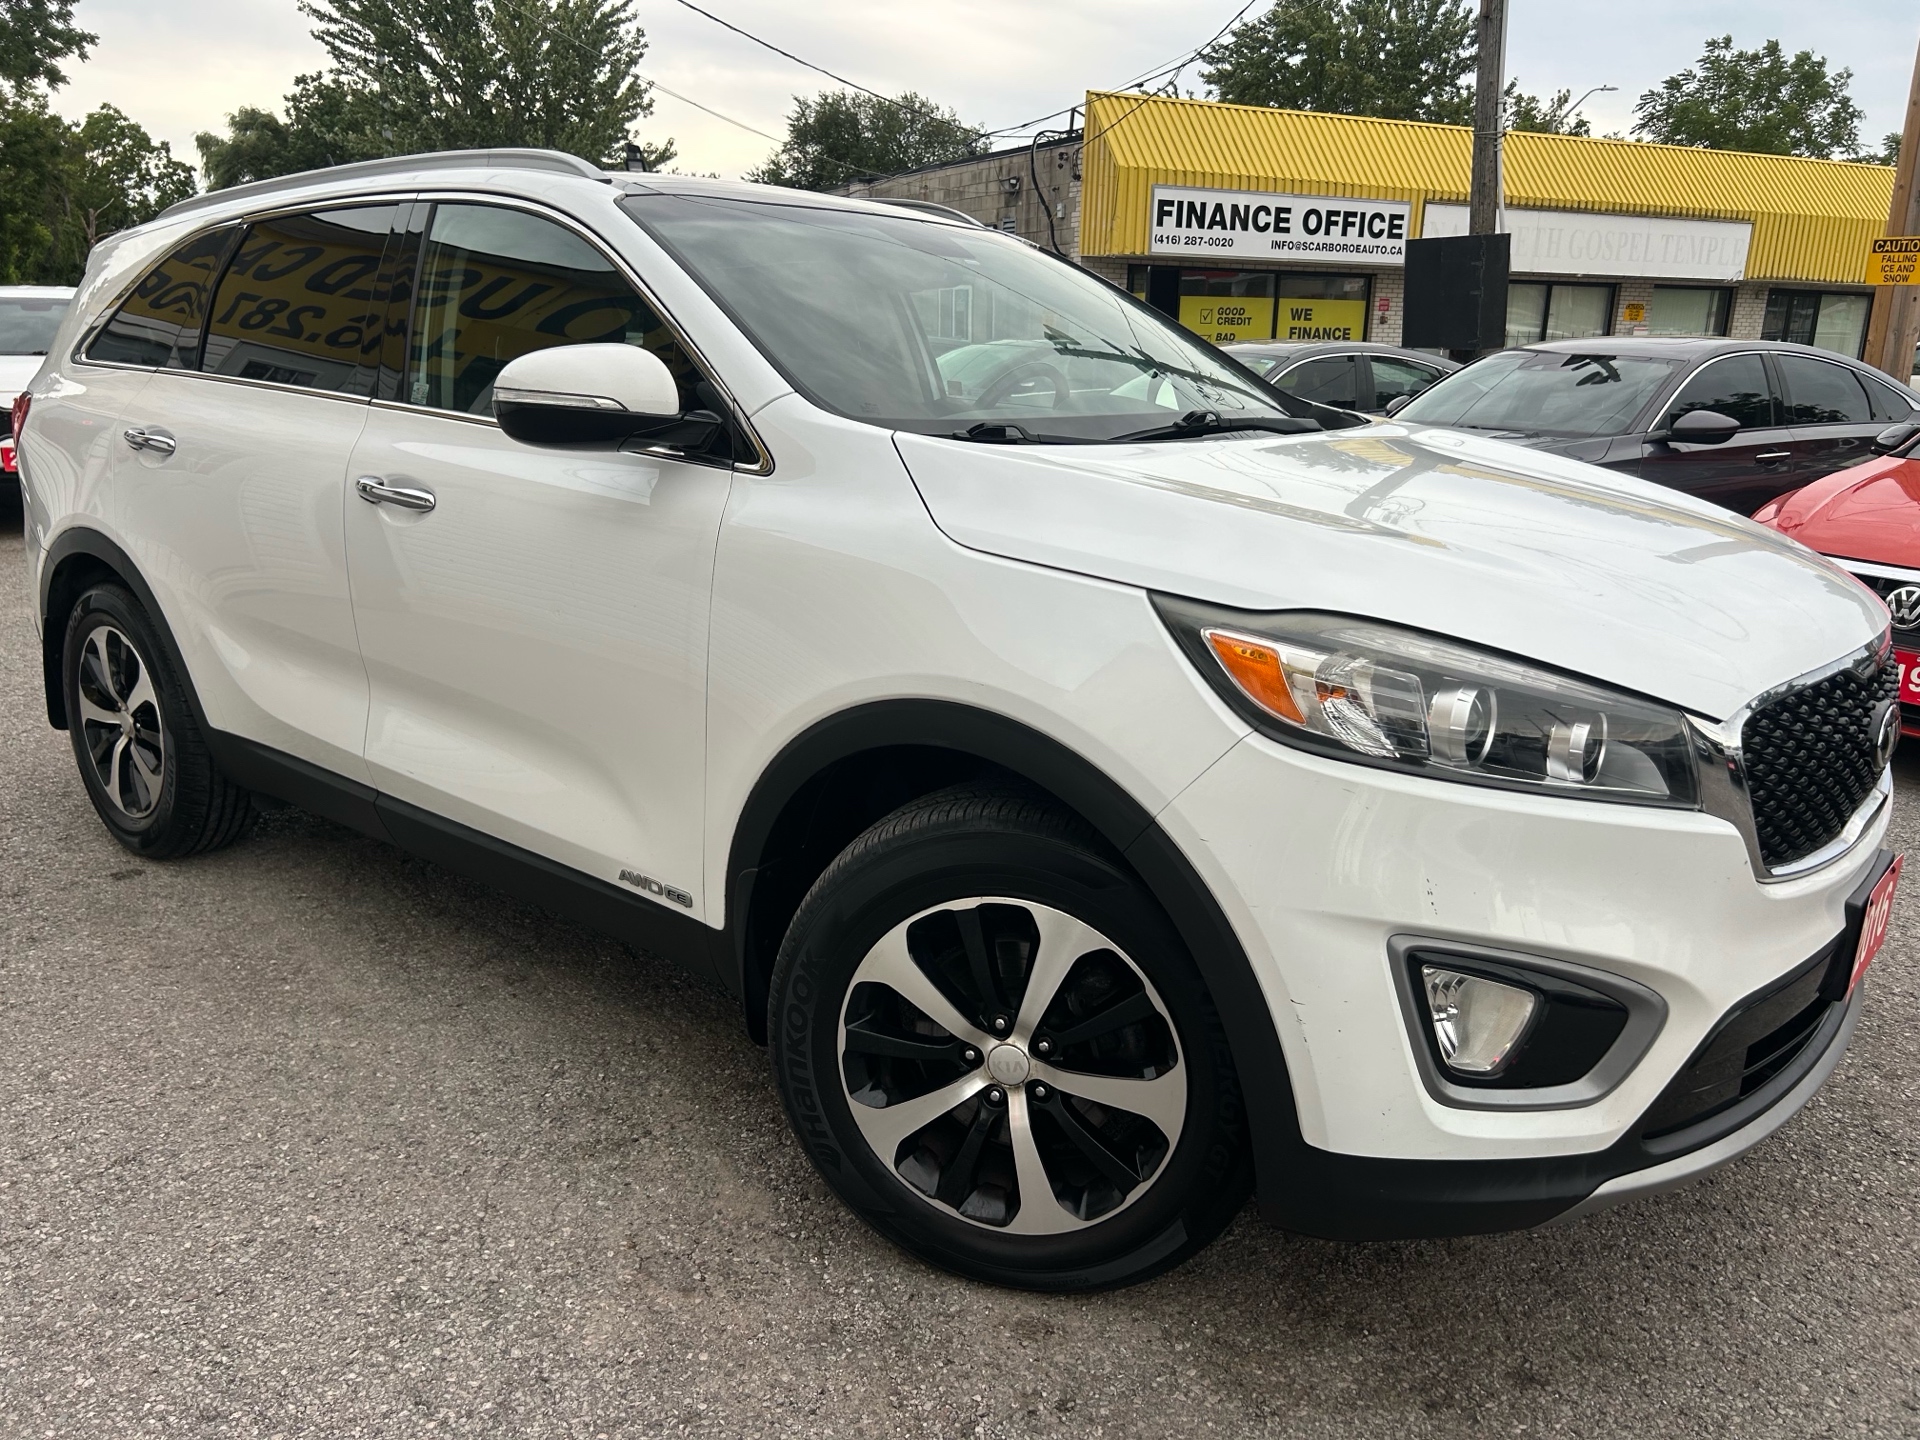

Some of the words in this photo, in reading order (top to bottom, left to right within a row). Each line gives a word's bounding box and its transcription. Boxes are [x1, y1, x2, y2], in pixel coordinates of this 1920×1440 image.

[1156, 199, 1292, 234] FINANCE
[1302, 208, 1405, 240] OFFICE
[1154, 234, 1181, 245] (416)
[1184, 236, 1234, 247] 287-0020
[1271, 240, 1403, 256] INFO@SCARBOROEAUTO.CA
[1568, 228, 1655, 264] GOSPEL
[1660, 234, 1746, 267] TEMPLE
[1881, 254, 1917, 263] FALLING
[1881, 264, 1895, 273] ICE
[1896, 264, 1915, 273] AND
[1883, 273, 1910, 283] SNOW
[1217, 307, 1245, 316] GOOD
[1290, 308, 1313, 321] WE
[1216, 316, 1252, 326] CREDIT
[1215, 333, 1236, 341] BAD
[1289, 327, 1351, 340] FINANCE
[618, 868, 664, 897] AWD
[991, 1060, 1026, 1074] KIA
